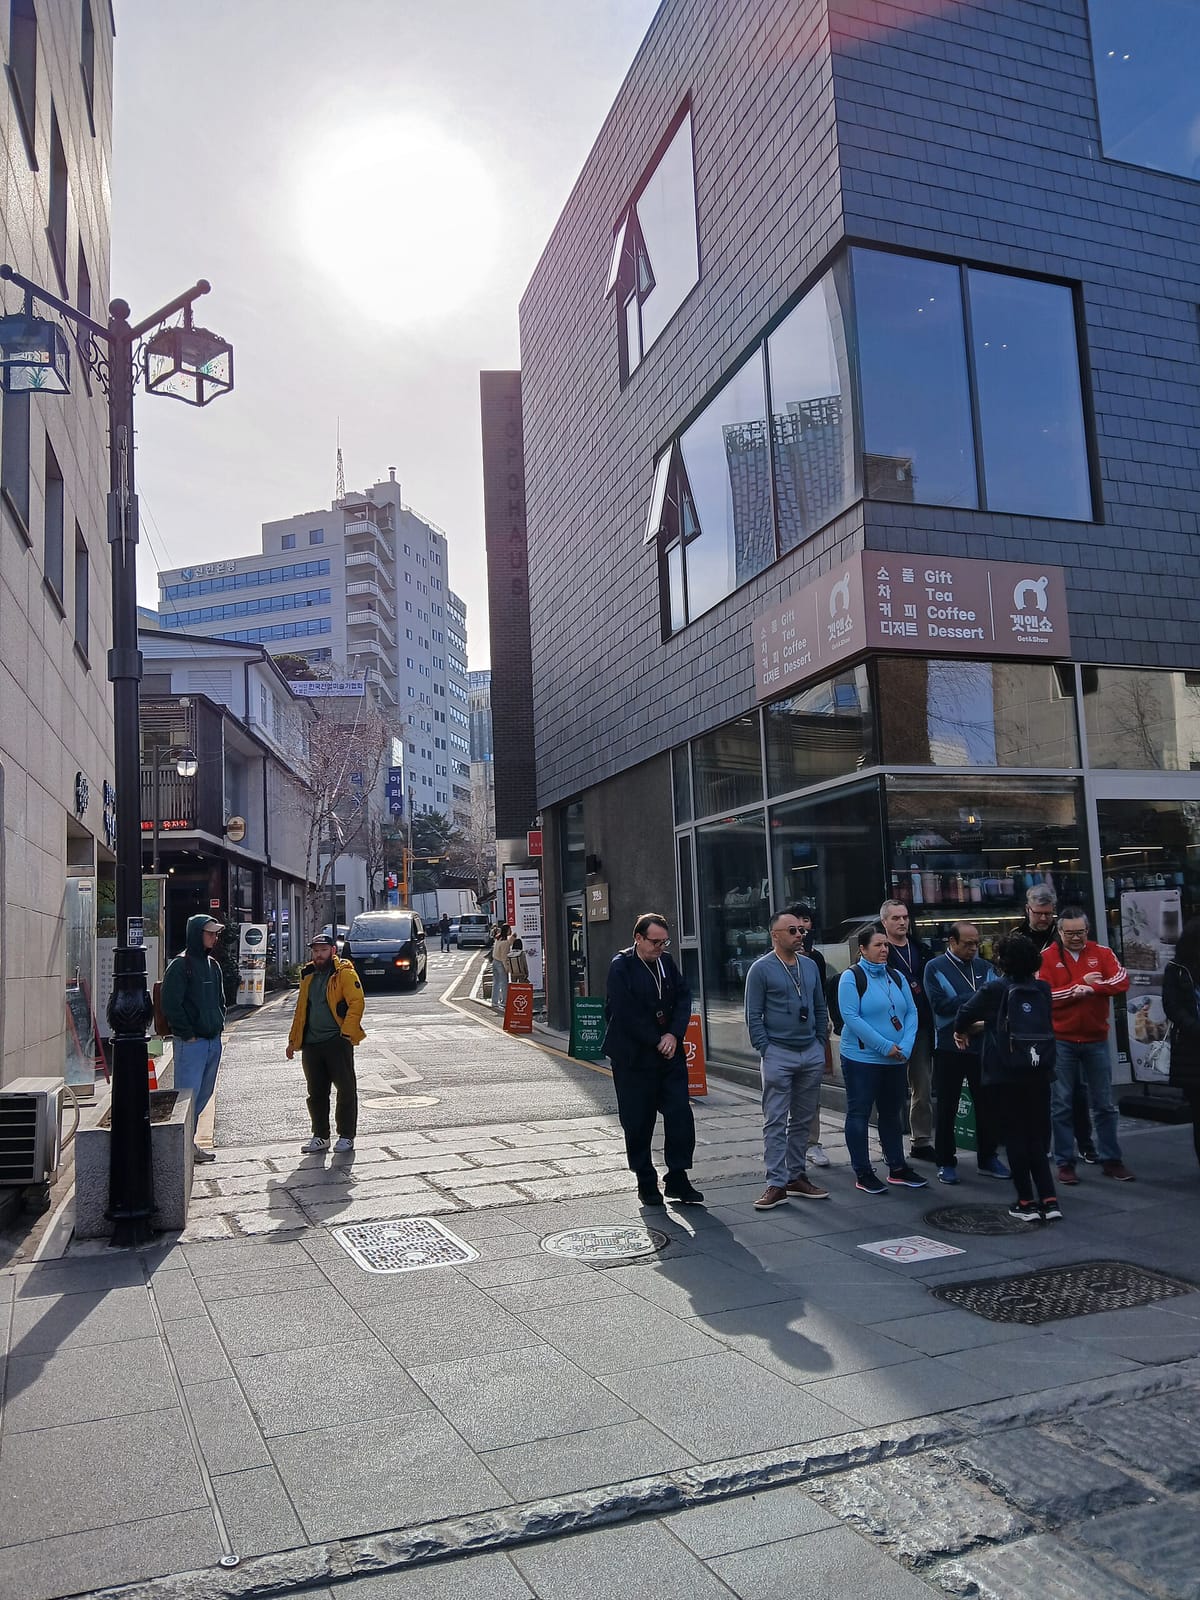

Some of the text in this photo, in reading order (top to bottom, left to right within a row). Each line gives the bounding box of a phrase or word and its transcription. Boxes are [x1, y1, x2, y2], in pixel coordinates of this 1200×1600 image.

[504, 396, 523, 595] TOPOHAUS
[924, 570, 953, 585] Gift
[878, 584, 953, 602] 차 Tea
[781, 609, 795, 626] Gift
[927, 605, 976, 622] Coffee
[880, 620, 984, 640] 디저트 Dessert
[1010, 614, 1054, 633] 겟앤쇼
[782, 628, 796, 642] Tea
[783, 638, 807, 658] Coffee
[763, 651, 812, 685] 디저트 Dessert
[390, 775, 402, 812] 아리수
